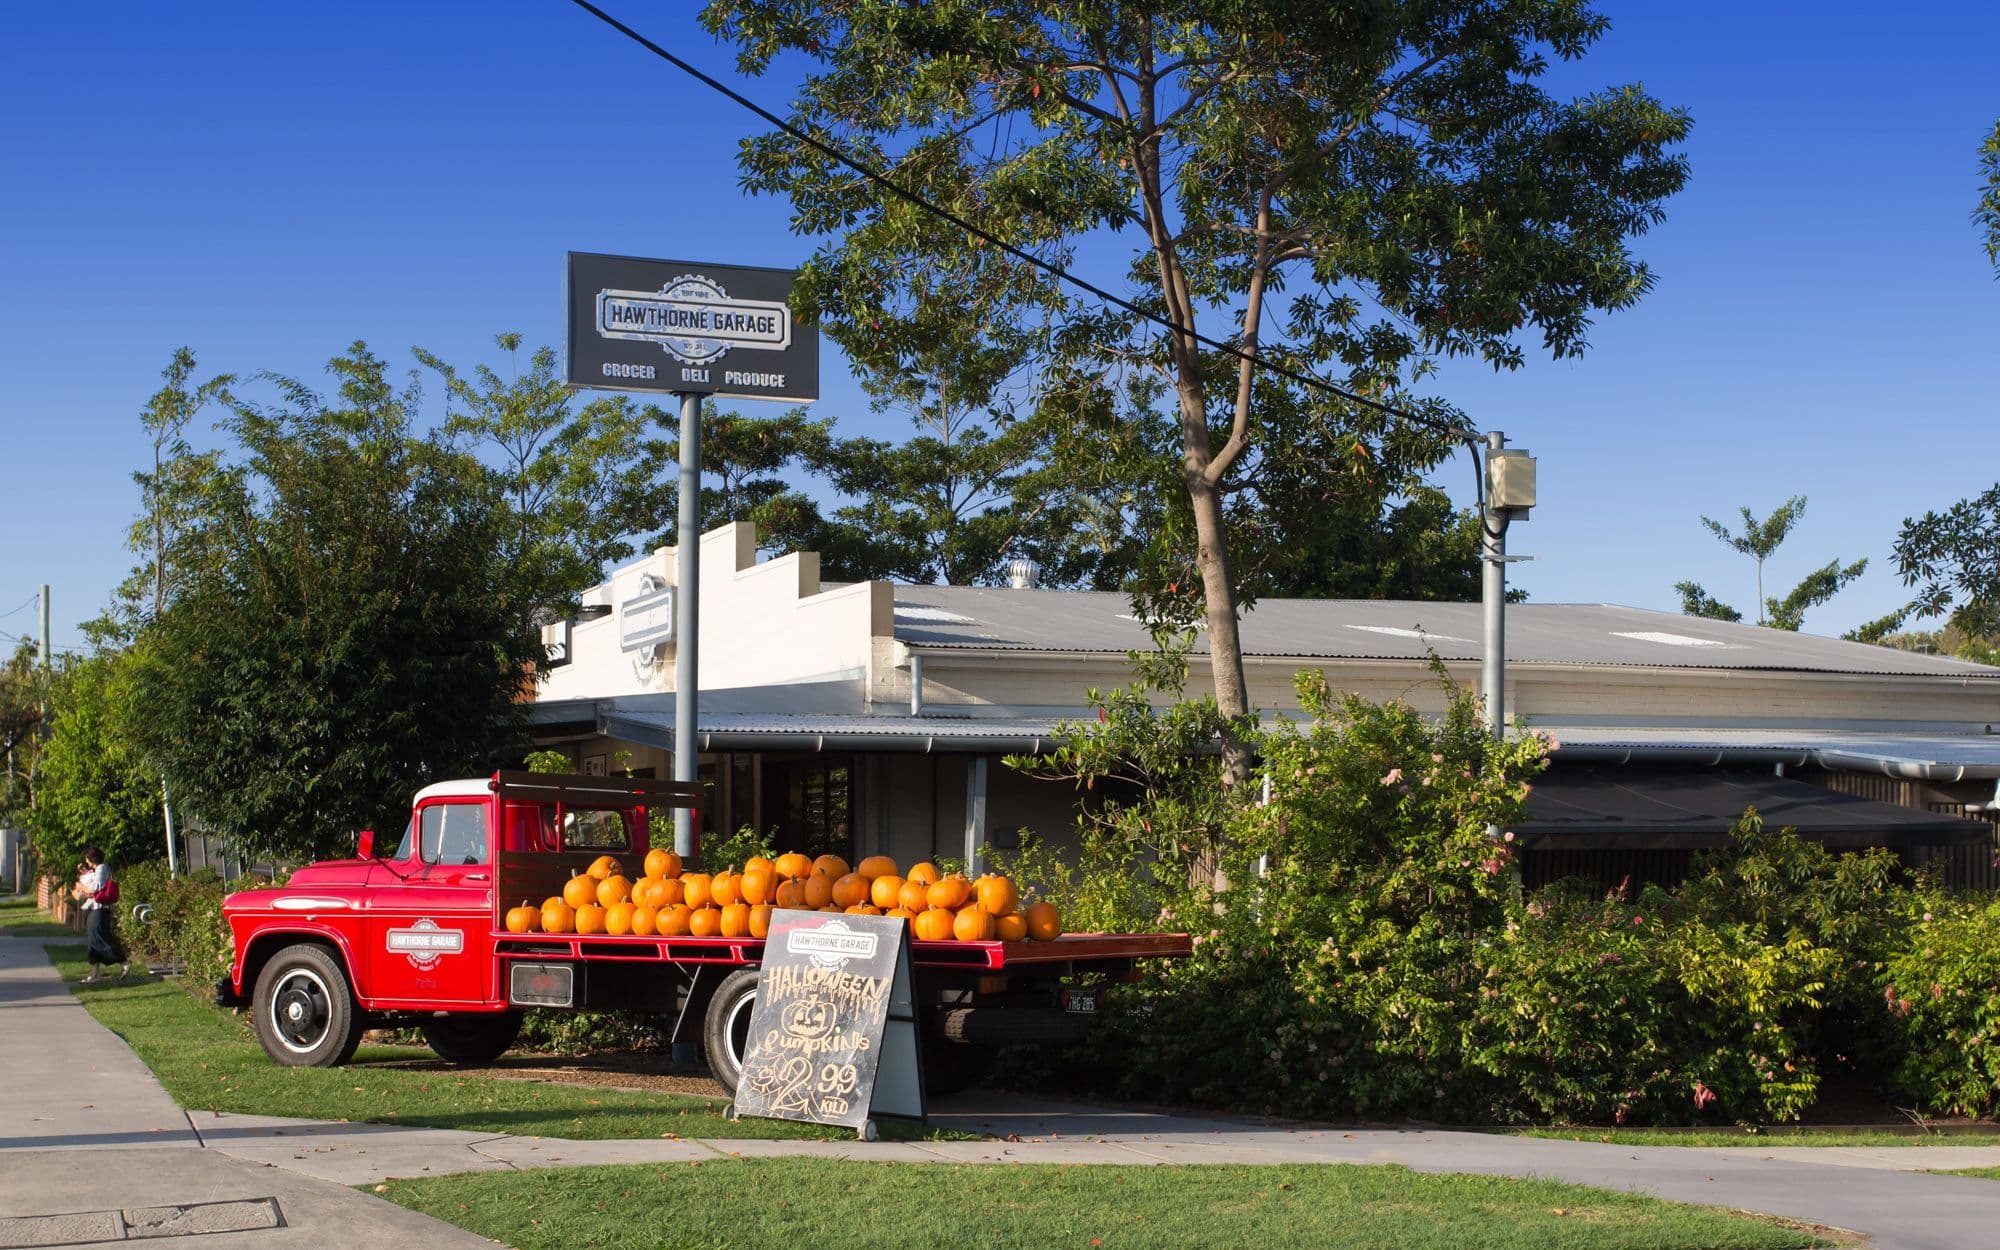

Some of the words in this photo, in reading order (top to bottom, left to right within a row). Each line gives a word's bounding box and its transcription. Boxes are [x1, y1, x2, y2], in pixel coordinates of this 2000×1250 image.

[612, 304, 708, 329] HAWTHORNE
[714, 312, 776, 334] GARAGE
[602, 362, 656, 380] GROCER
[681, 367, 710, 383] DELI
[725, 370, 785, 388] PRODUCE
[392, 935, 430, 947] HAWTHORNE
[431, 935, 458, 948] GARAGE
[795, 934, 839, 949] HAWTHORNE
[840, 937, 870, 951] GARAGE
[764, 964, 889, 1020] HALLOWEEN
[821, 1099, 848, 1115] KILO
